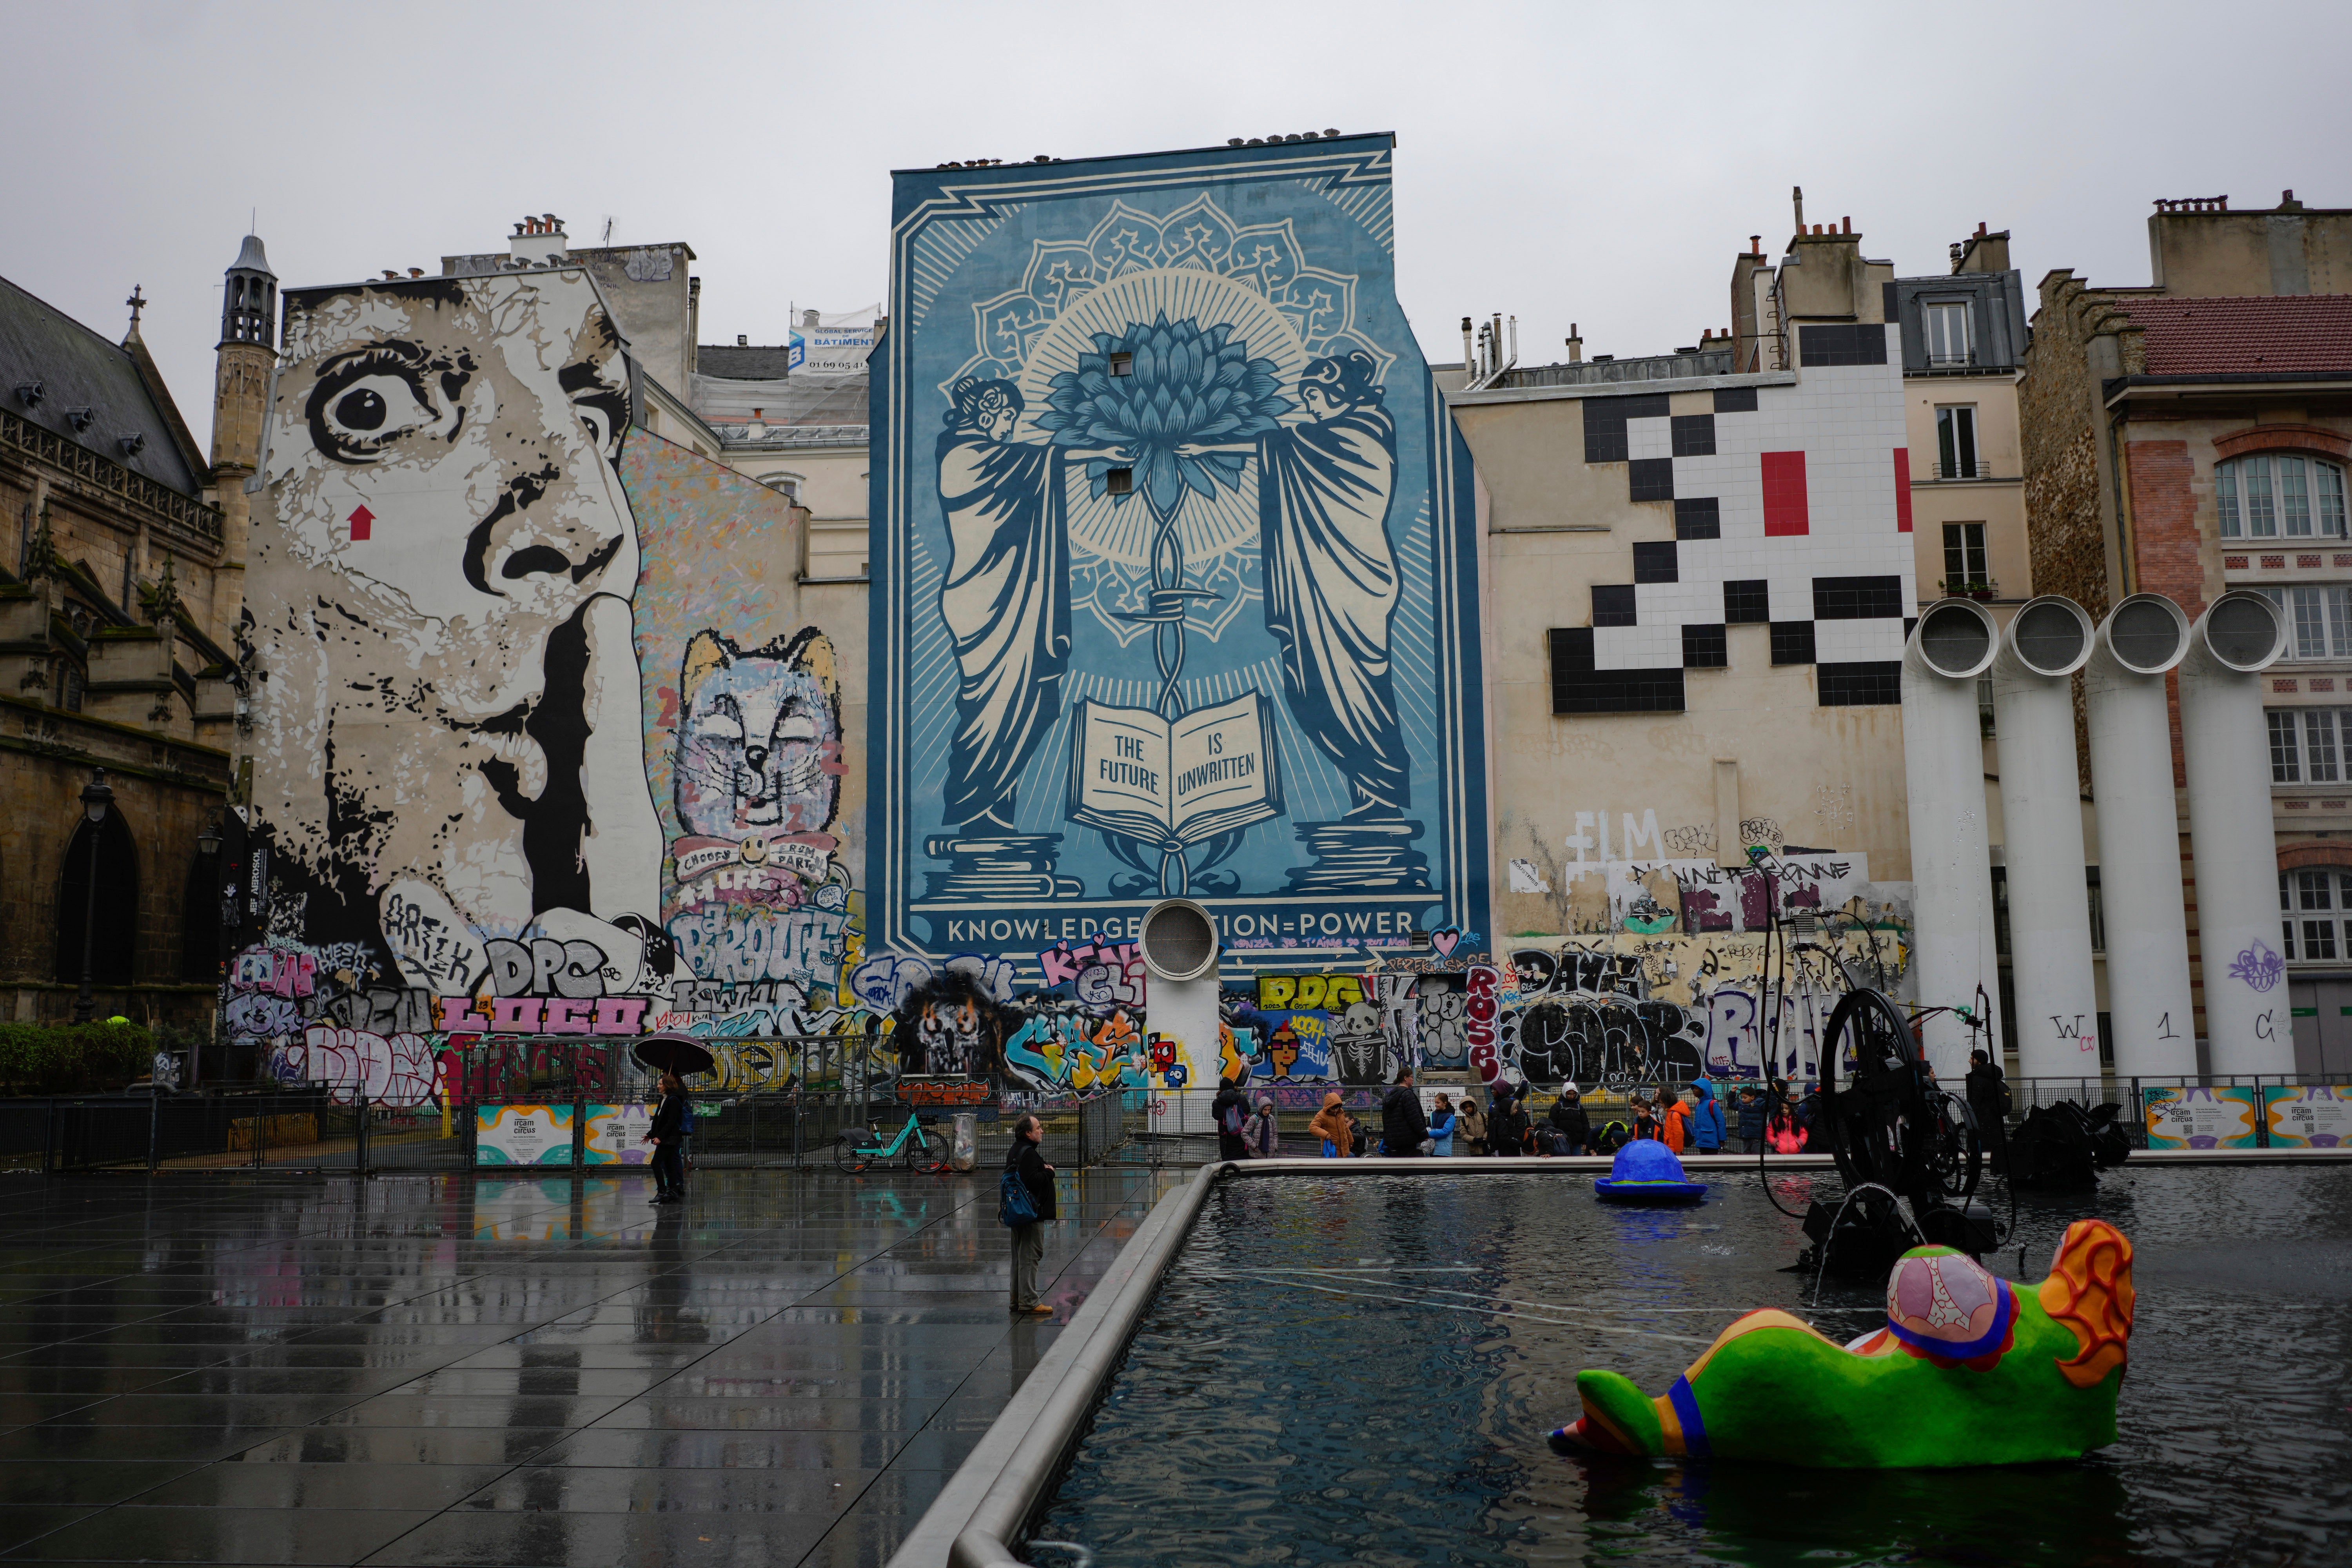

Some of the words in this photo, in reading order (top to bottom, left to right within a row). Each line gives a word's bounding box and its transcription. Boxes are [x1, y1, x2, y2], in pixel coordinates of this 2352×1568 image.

[823, 361, 835, 369] 69
[1114, 735, 1144, 762] THE
[1208, 732, 1222, 756] IS
[1100, 758, 1159, 796] FUTURE
[1178, 752, 1255, 796] UNWRITTEN
[250, 848, 261, 896] AEROSOL
[249, 897, 258, 916] JEF
[948, 917, 1141, 942] KNOWLEDGE
[438, 996, 648, 1034] LOCO
[2049, 1015, 2085, 1038] W
[892, 1130, 907, 1148] TIER
